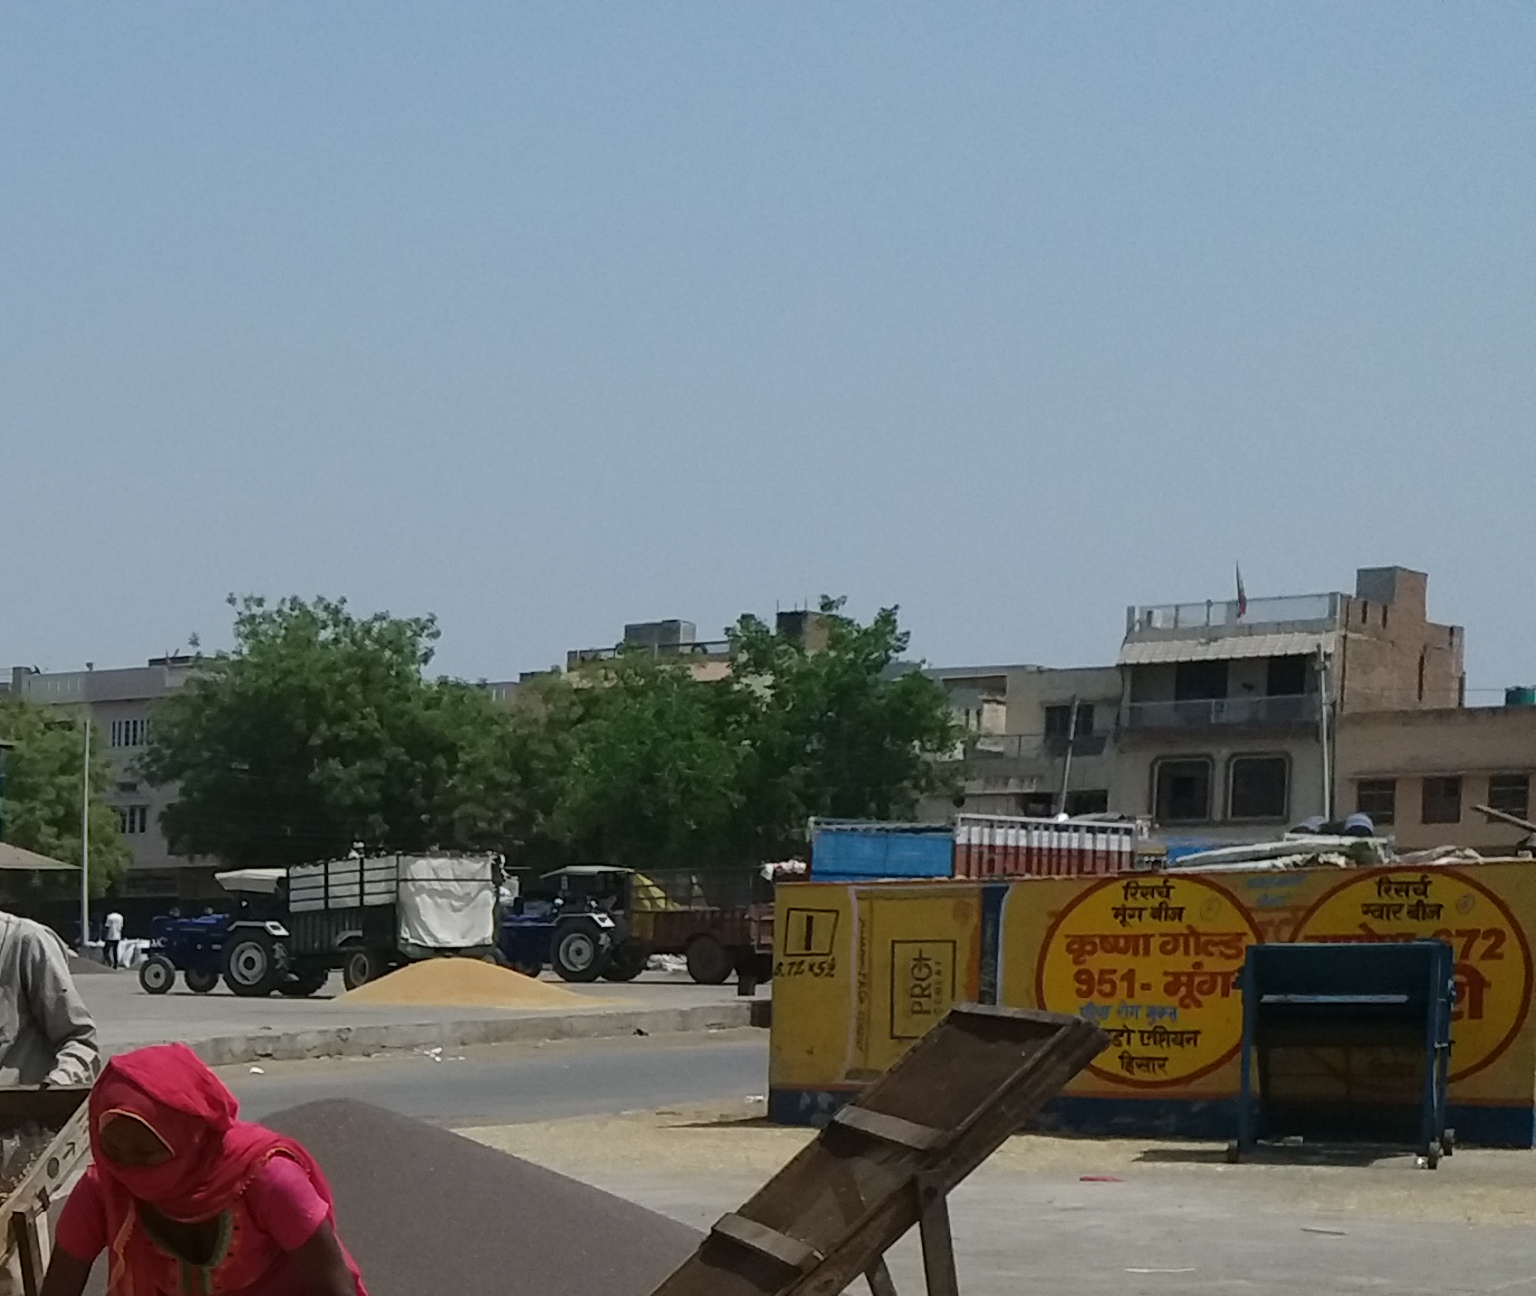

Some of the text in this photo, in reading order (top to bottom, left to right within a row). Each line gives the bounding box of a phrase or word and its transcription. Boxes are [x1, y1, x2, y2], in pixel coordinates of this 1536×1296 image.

[1122, 878, 1175, 900] रिसर्च
[1376, 874, 1431, 899] रिसर्च
[1149, 901, 1185, 922] बीज
[1406, 899, 1444, 922] बीज
[1065, 933, 1153, 966] कृष्णा
[1159, 925, 1247, 961] गोल्ड
[1118, 1052, 1169, 1076] हिसार
